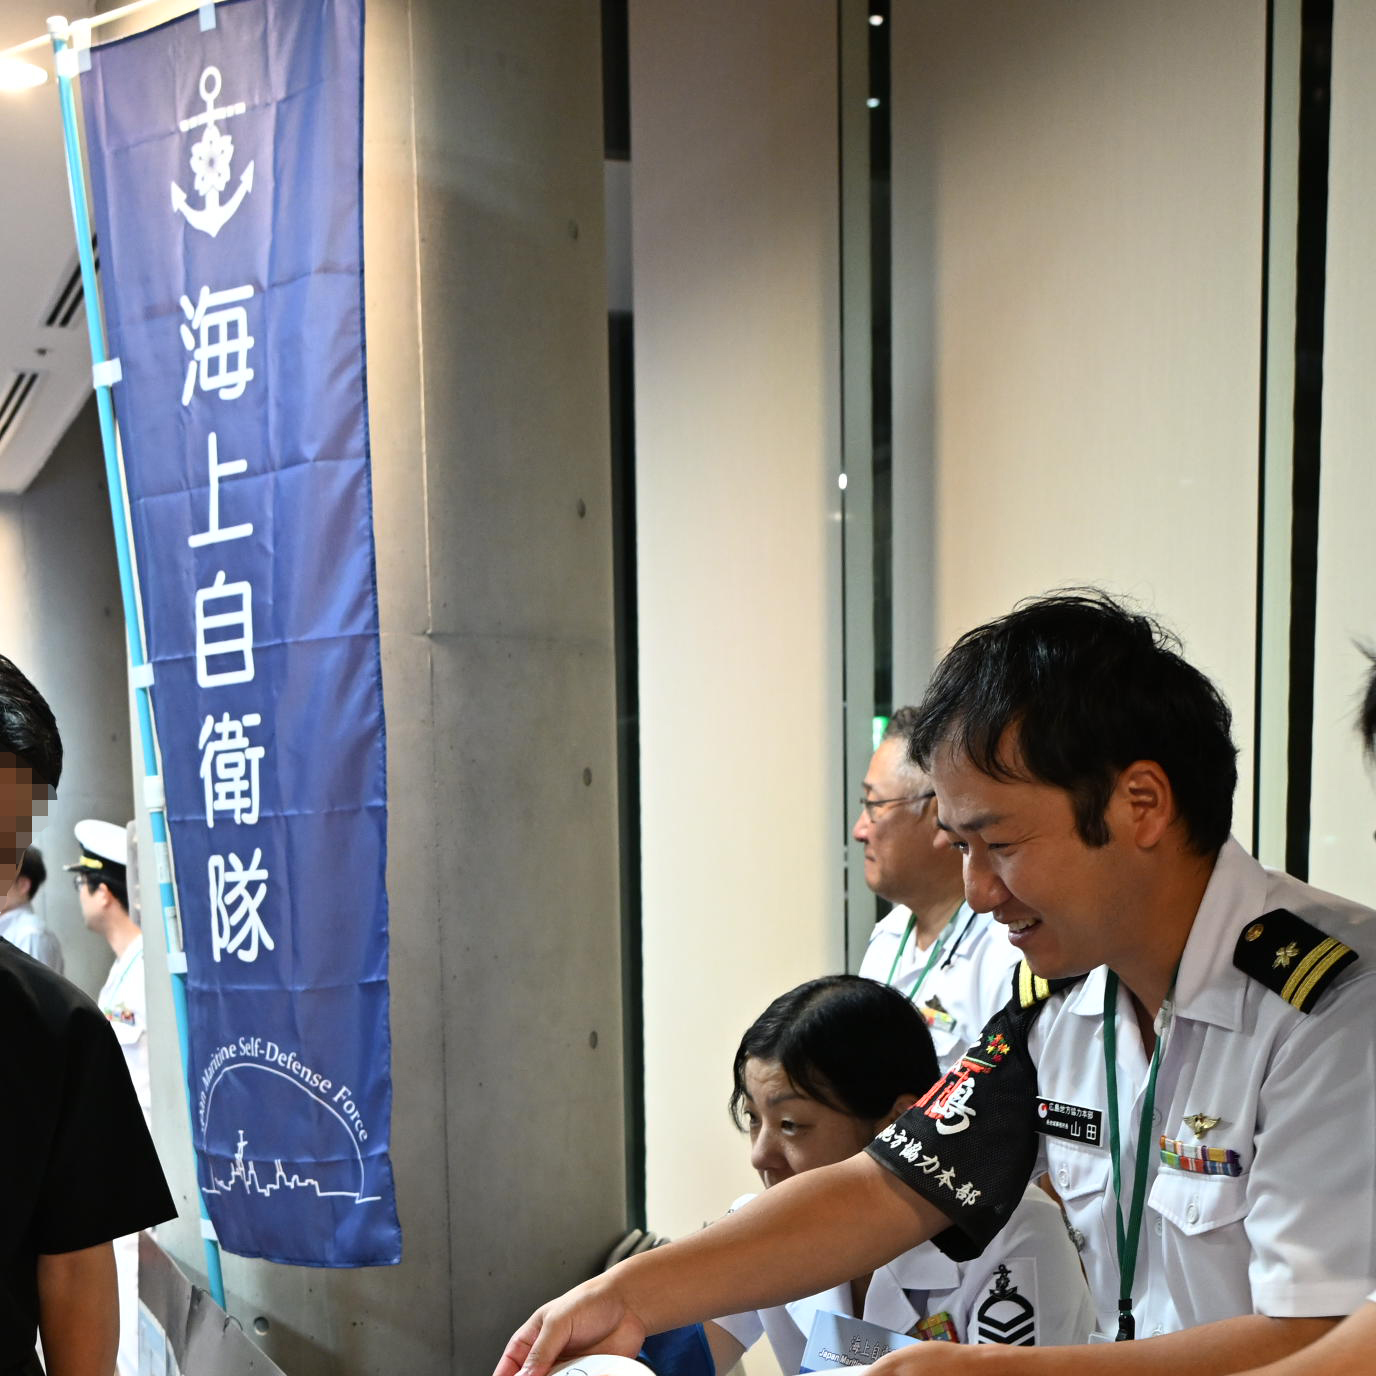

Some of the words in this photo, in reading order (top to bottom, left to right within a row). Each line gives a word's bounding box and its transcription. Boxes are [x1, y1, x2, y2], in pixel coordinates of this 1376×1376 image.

[177, 284, 275, 964] 海上自衛隊
[239, 1036, 332, 1093] Self-Defense
[332, 1085, 369, 1143] Force
[1070, 1120, 1097, 1140] 山田
[819, 1348, 840, 1363] Japan
